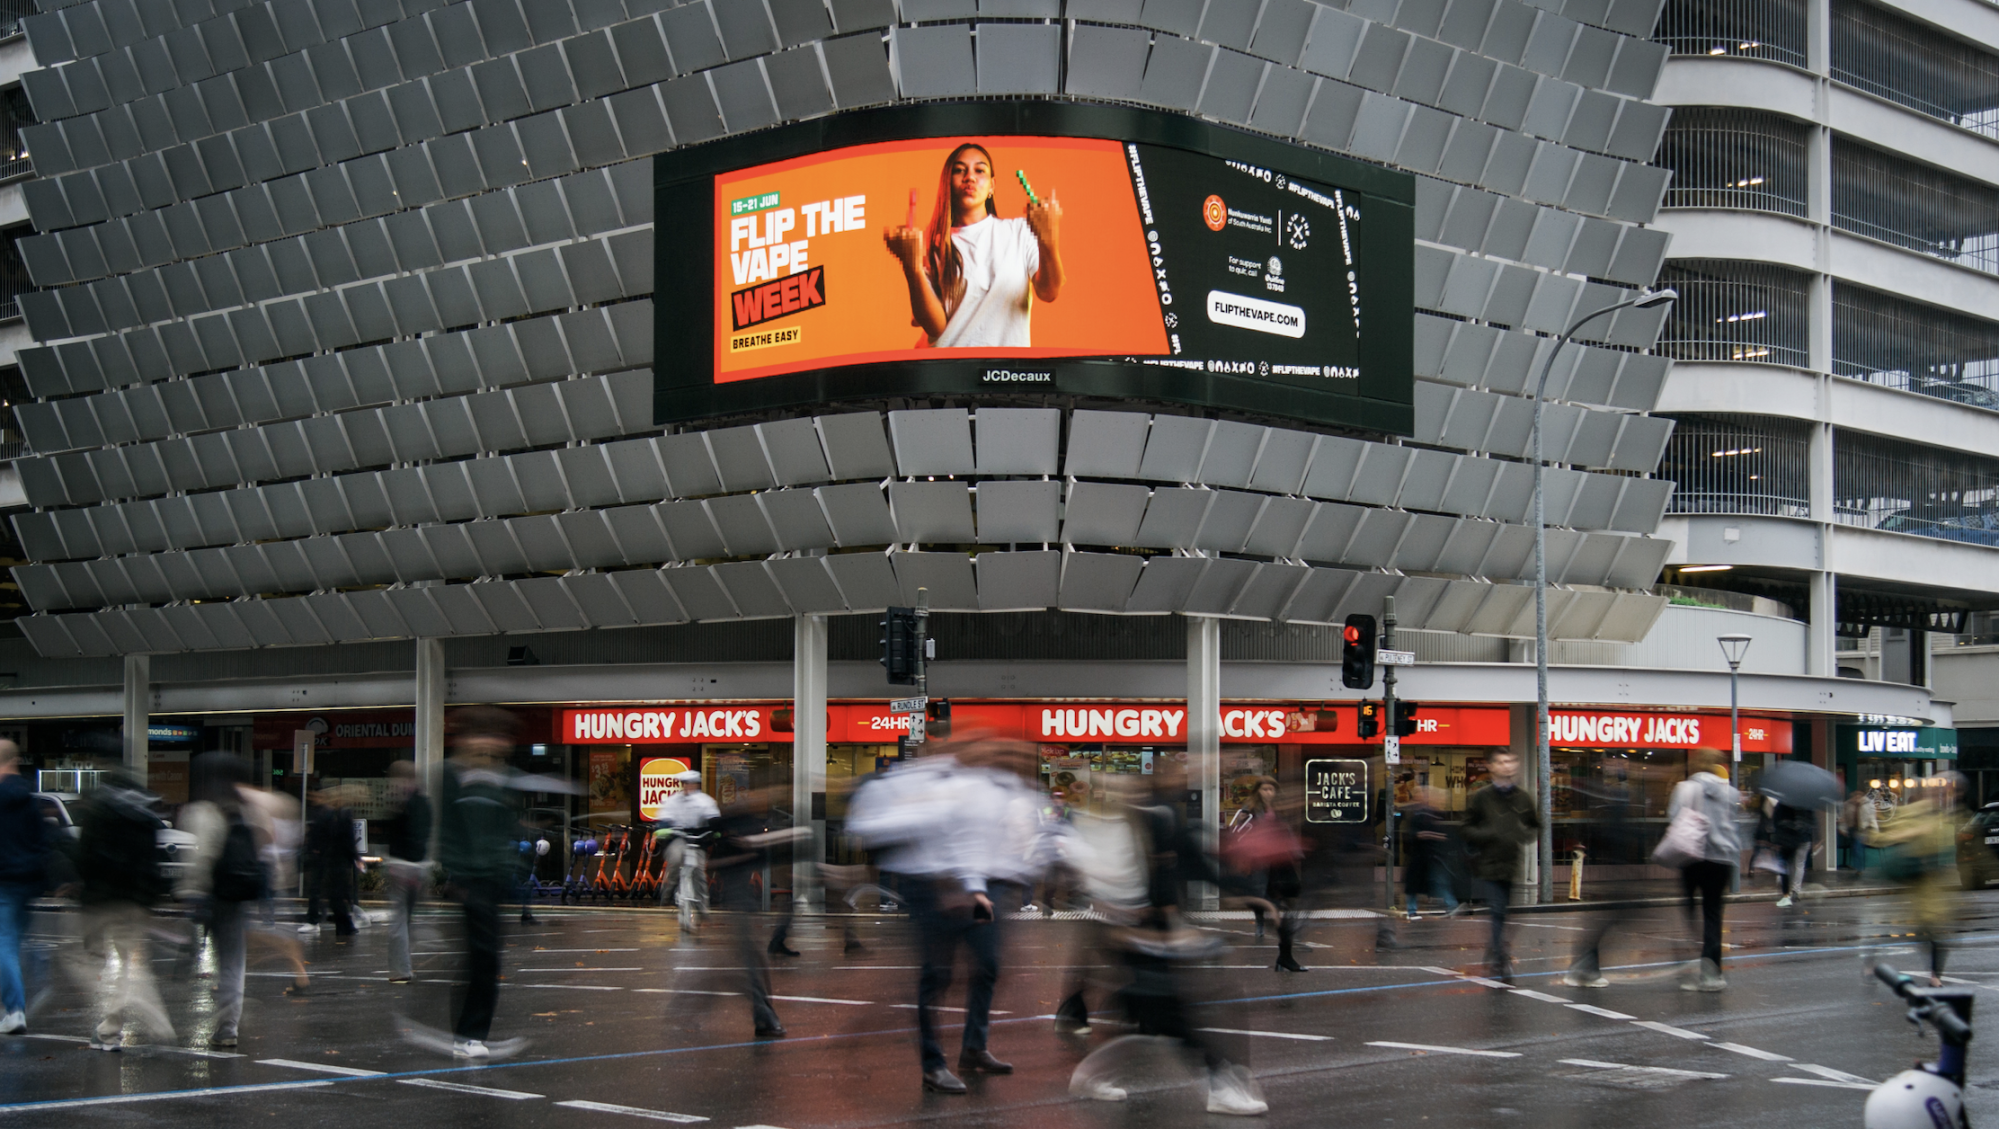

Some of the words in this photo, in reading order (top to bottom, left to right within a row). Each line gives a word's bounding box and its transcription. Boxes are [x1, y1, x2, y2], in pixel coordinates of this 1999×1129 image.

[733, 199, 757, 213] 15-21
[760, 194, 779, 208] JUN
[731, 208, 795, 252] FLIP
[801, 195, 865, 237] THE
[731, 240, 808, 285] VAPE
[733, 269, 822, 326] WEEK
[1215, 302, 1298, 327] FLIPTHEVAPE.COM
[733, 333, 772, 349] BREATHE
[775, 329, 798, 343] EASY
[983, 370, 1051, 381] JCDecaux
[897, 700, 916, 710] RUNDLE
[918, 699, 924, 708] ST
[148, 728, 172, 736] monds
[336, 723, 389, 738] ORIENTAL
[575, 712, 676, 739] HUNGRY
[679, 710, 760, 738] JACK'S
[871, 716, 910, 730] 24HR
[1042, 709, 1184, 737] HUNGRY
[1219, 710, 1286, 738] CK'S
[1416, 719, 1437, 732] HR
[1548, 715, 1642, 742] HUNGRY
[1644, 717, 1700, 744] JACK'S
[1858, 731, 1885, 752] LIV
[1886, 731, 1917, 752] EAT
[1317, 772, 1355, 786] JACK'S
[1322, 786, 1351, 799] CAFE
